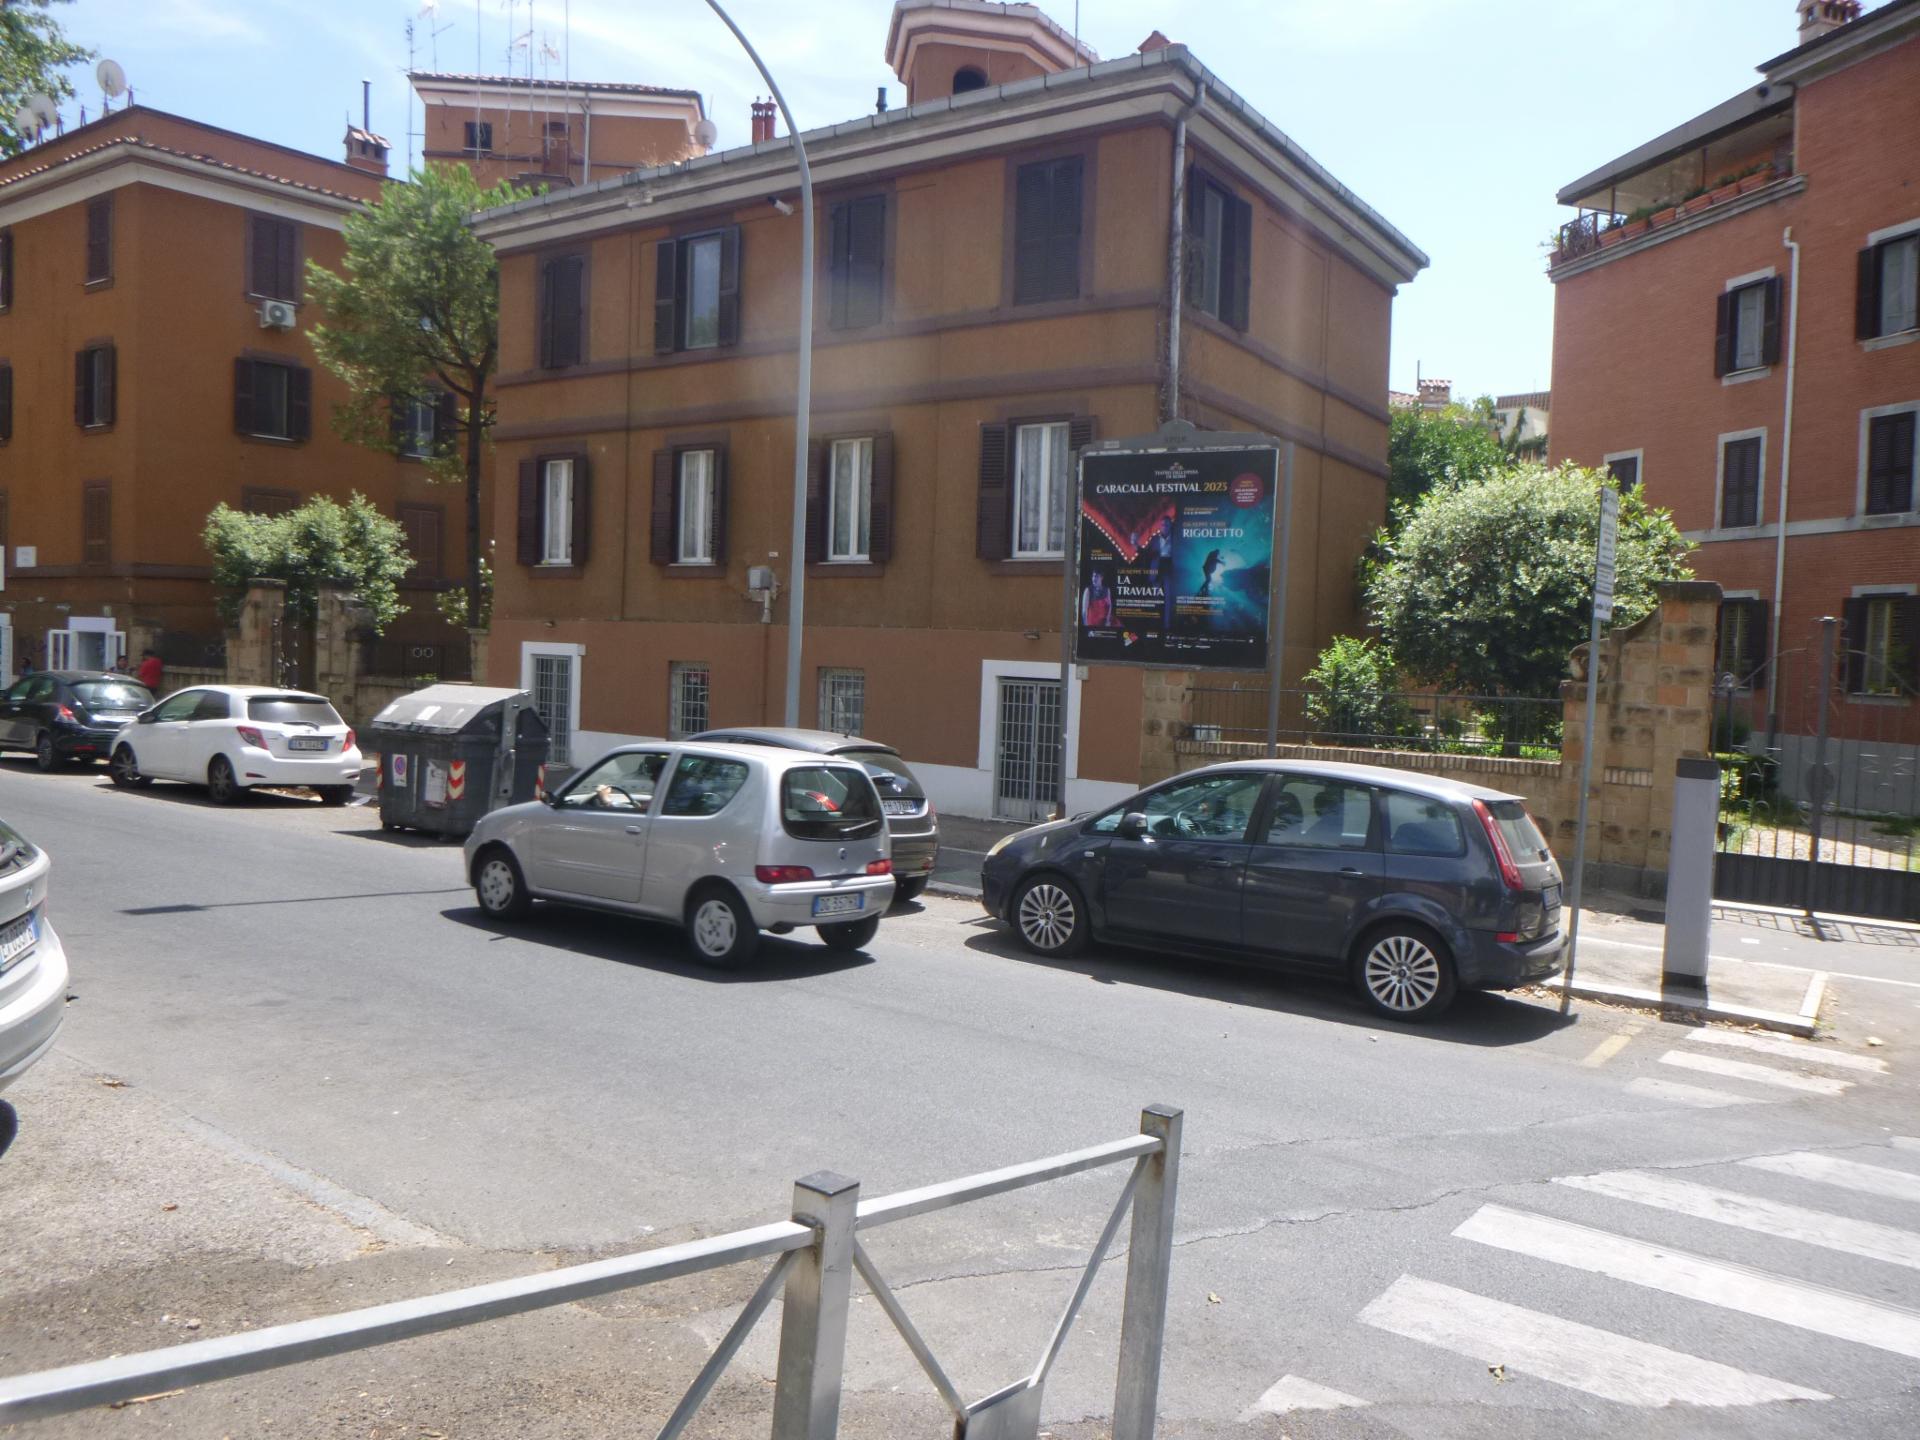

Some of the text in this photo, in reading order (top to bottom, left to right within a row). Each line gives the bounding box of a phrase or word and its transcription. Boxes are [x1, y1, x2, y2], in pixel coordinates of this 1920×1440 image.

[1096, 483, 1154, 494] CARACALLA
[1155, 482, 1201, 493] FESTIVAL
[1183, 529, 1244, 538] RIGOLETTO
[1117, 575, 1131, 585] LA
[1117, 586, 1165, 596] TRAVIATA
